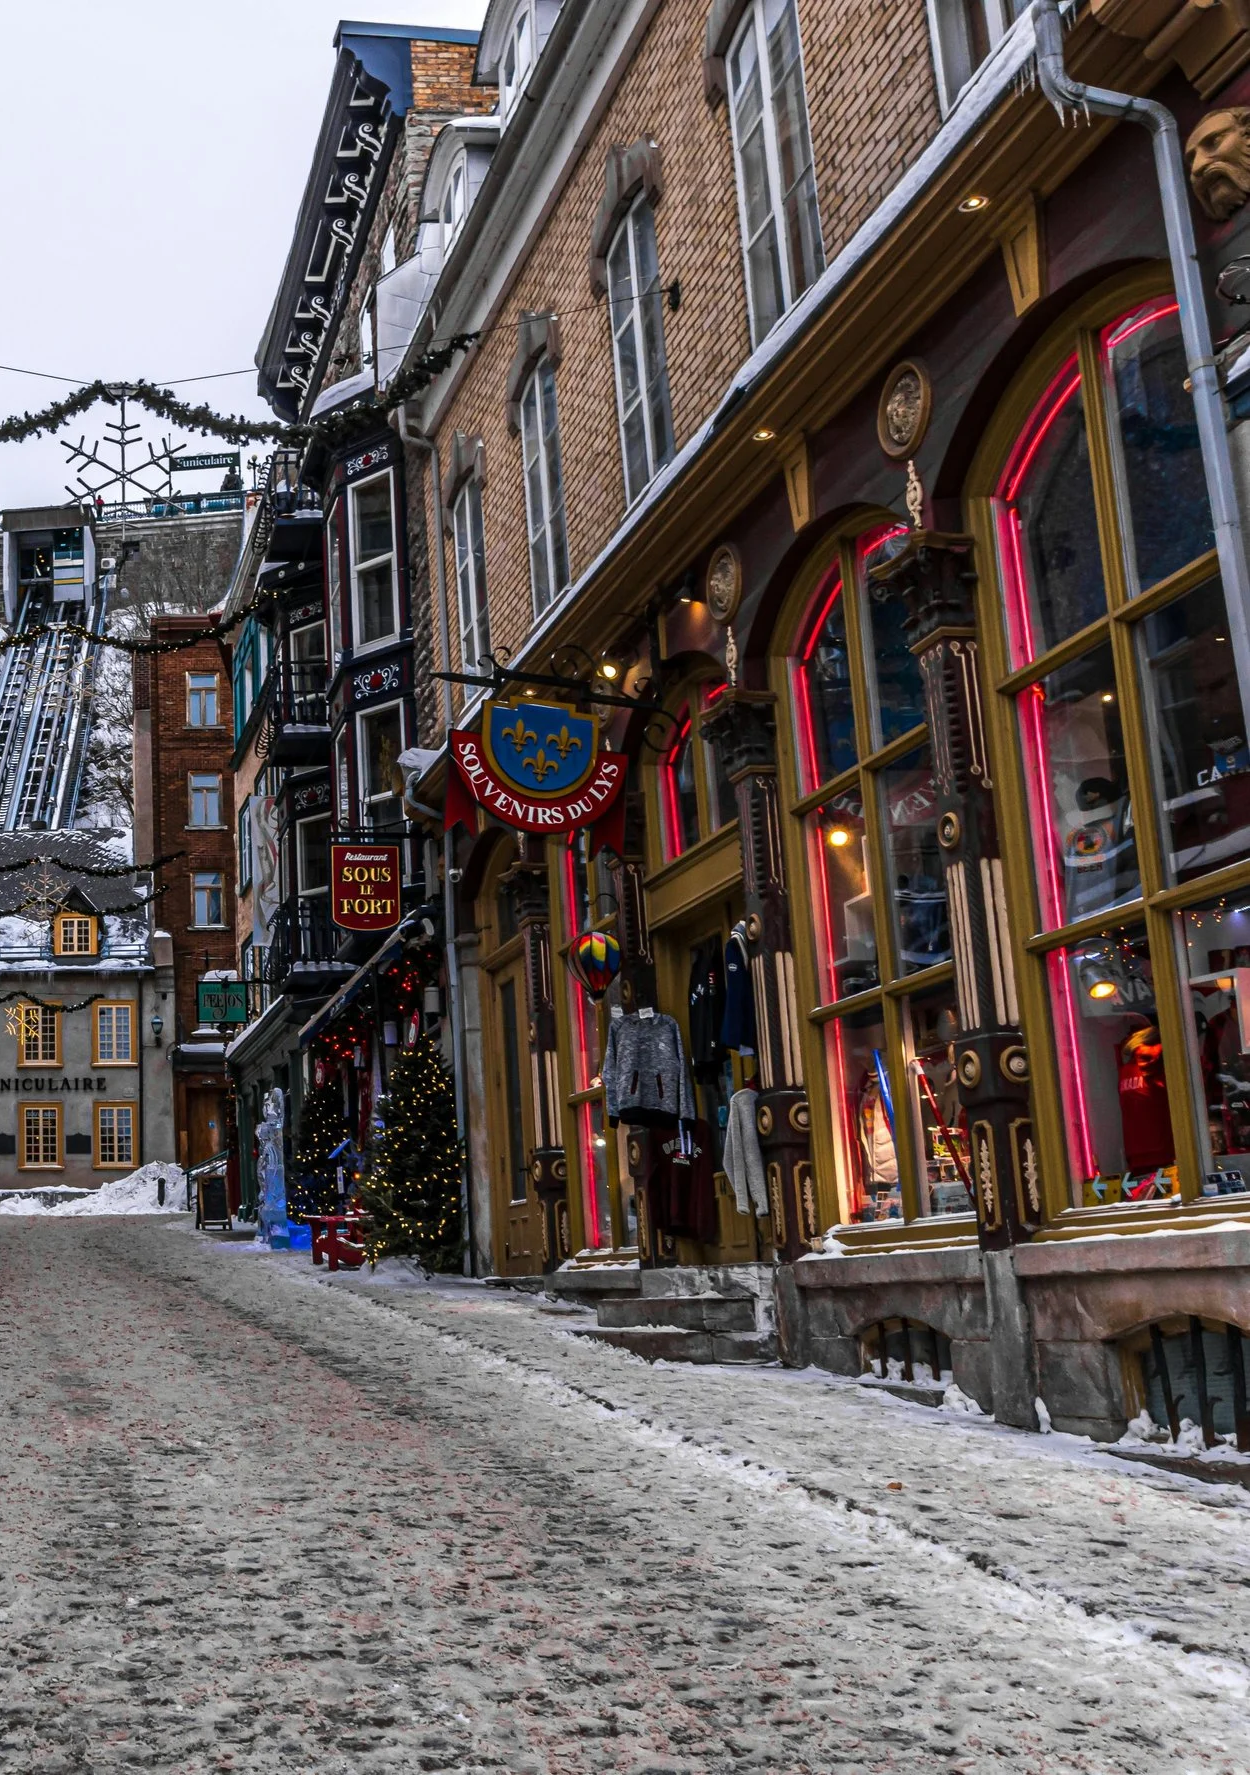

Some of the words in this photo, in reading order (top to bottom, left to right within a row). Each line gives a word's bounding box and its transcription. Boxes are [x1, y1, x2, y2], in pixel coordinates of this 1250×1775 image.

[458, 741, 566, 825] SOUVENIRS
[565, 795, 594, 821] DU
[588, 760, 620, 803] LYS
[344, 851, 390, 862] Restaurant
[341, 866, 392, 883] SOUS
[360, 884, 375, 896] LE
[340, 898, 396, 915] FORT
